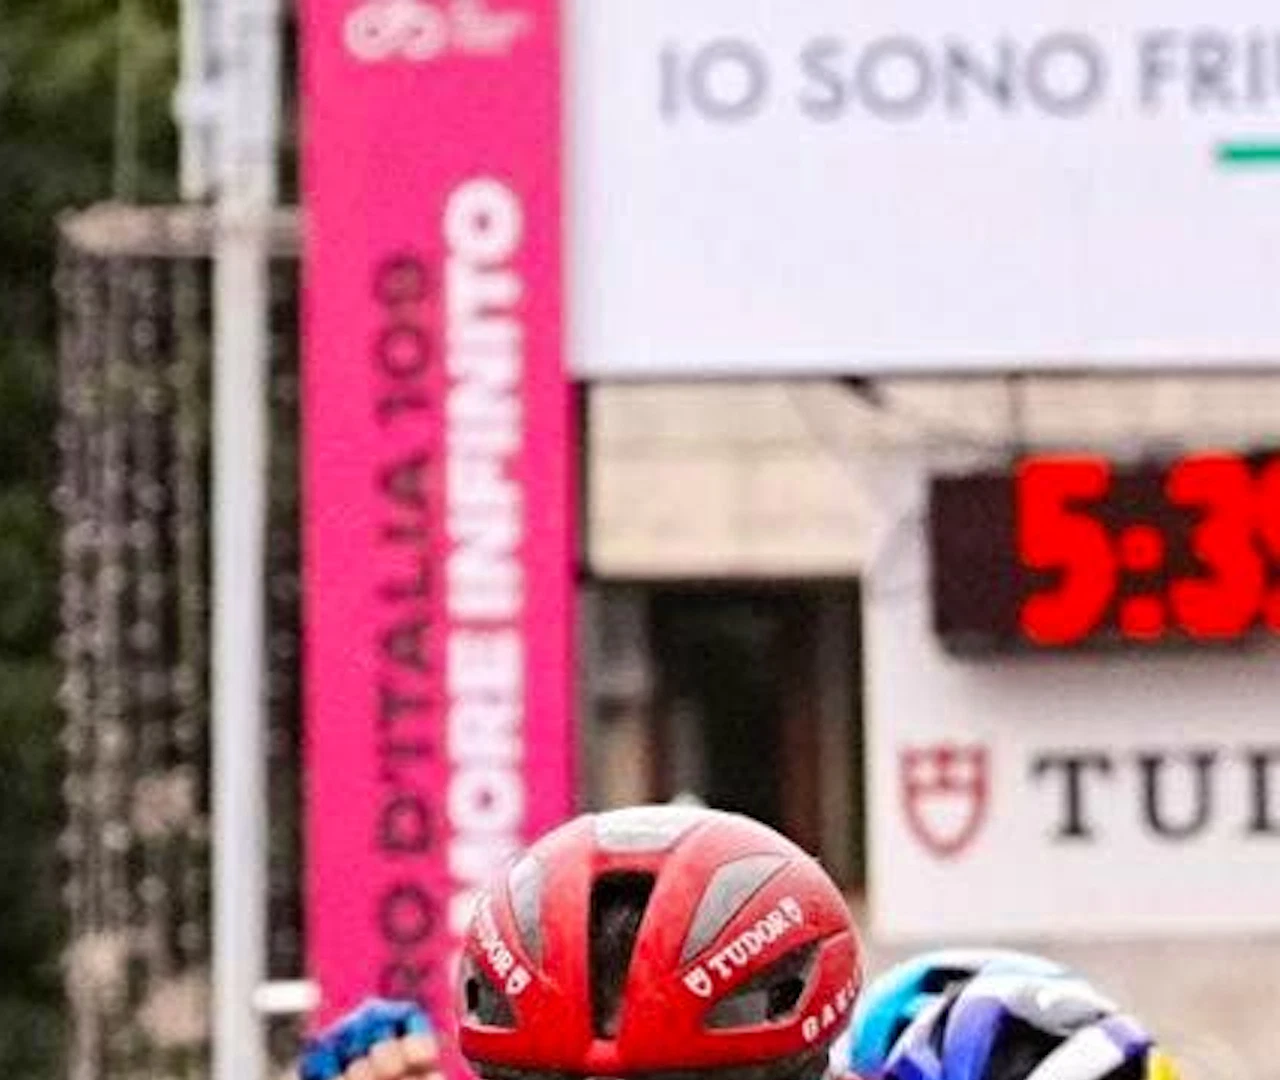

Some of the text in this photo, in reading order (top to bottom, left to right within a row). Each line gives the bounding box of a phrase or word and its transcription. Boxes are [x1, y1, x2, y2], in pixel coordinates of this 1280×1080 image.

[657, 29, 1280, 123] IO SONO FRI
[374, 252, 428, 428] 109
[443, 176, 525, 622] INFINITO
[1015, 452, 1280, 645] 5:3
[706, 911, 791, 981] TUDOR
